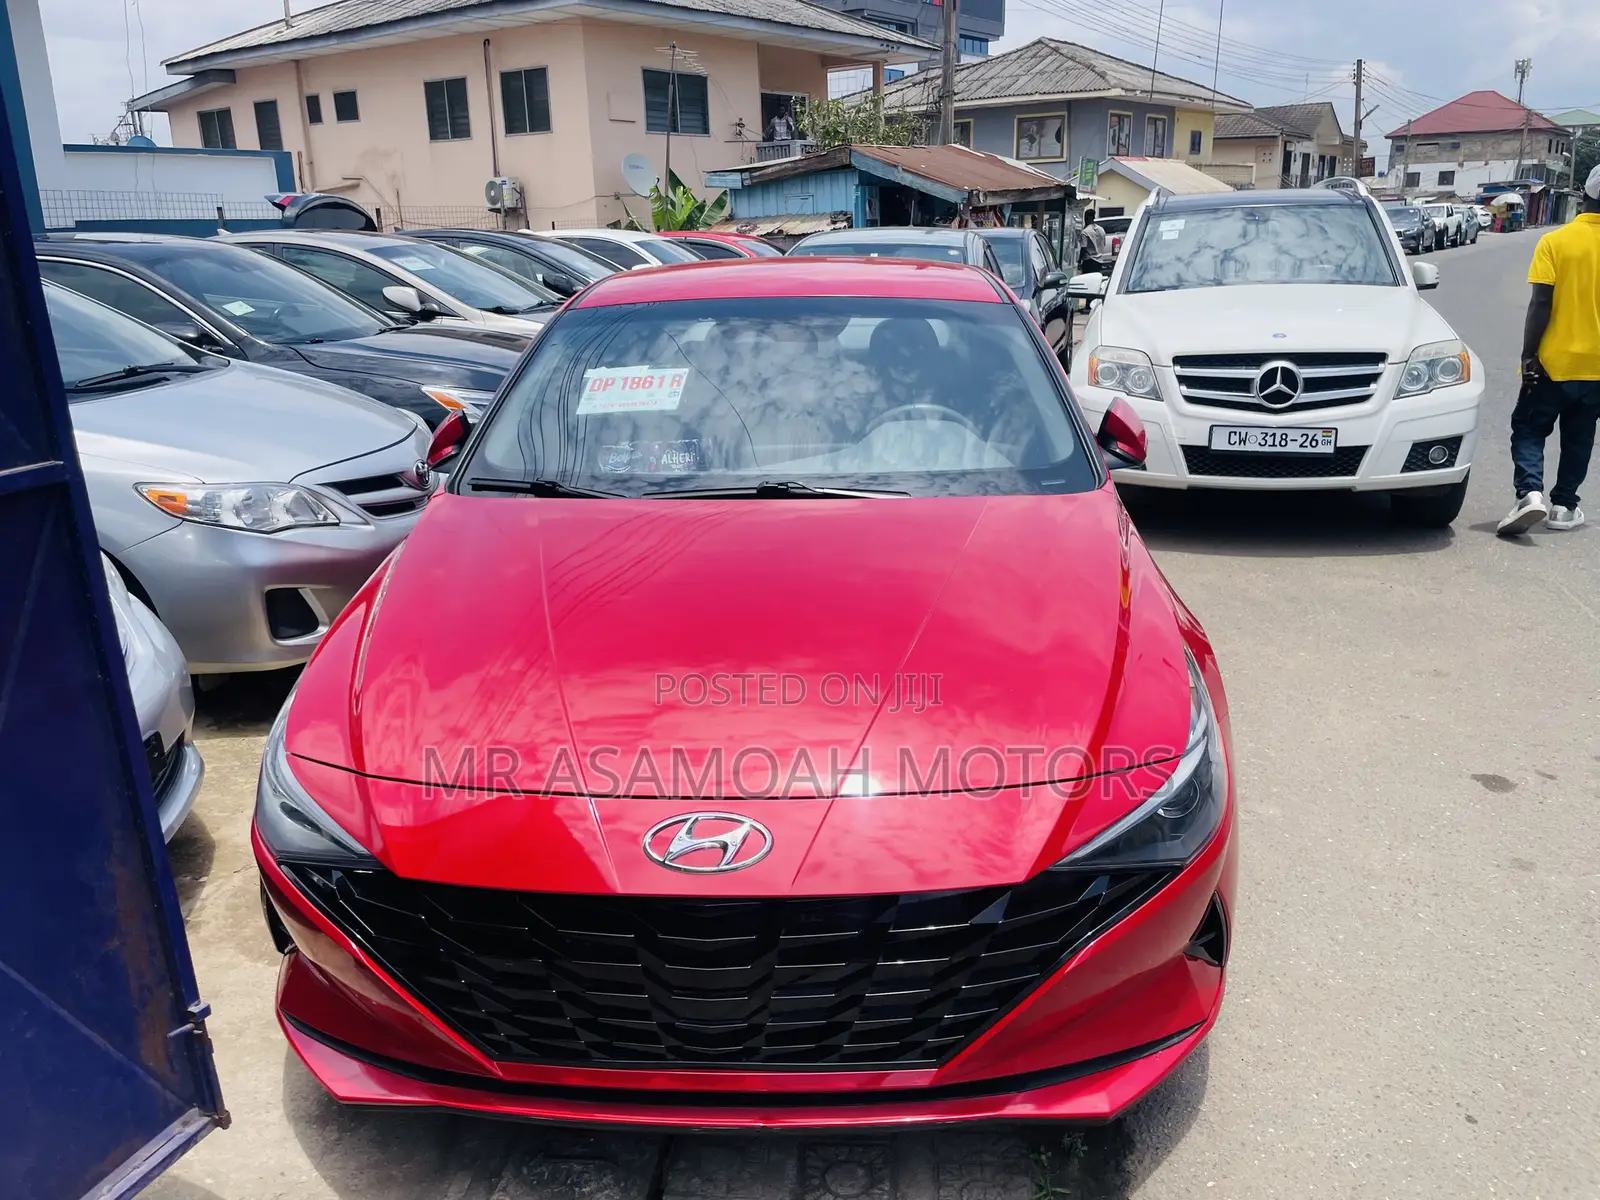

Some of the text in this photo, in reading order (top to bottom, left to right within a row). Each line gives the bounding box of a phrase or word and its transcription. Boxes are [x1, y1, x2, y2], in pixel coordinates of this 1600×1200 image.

[589, 376, 616, 392] DP
[621, 375, 666, 392] 1861
[1227, 430, 1319, 448] CW 318-26
[1321, 438, 1332, 446] GH
